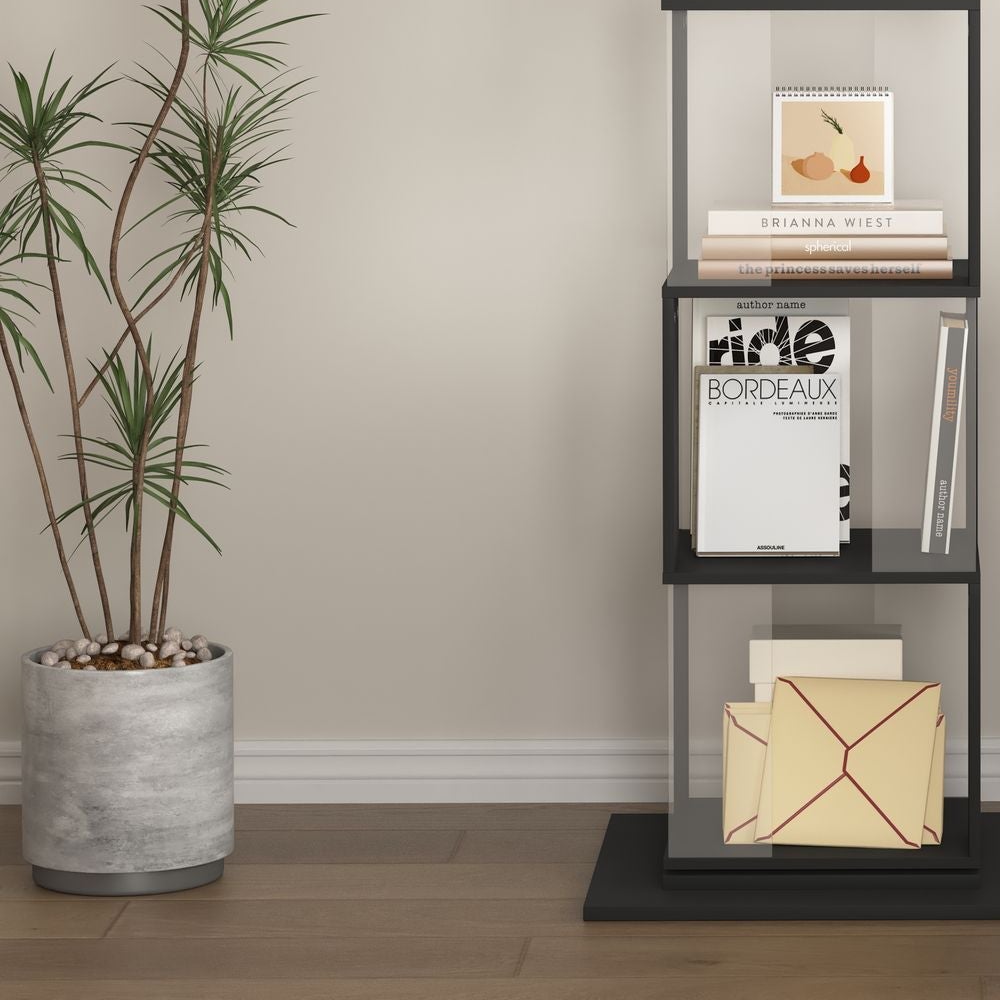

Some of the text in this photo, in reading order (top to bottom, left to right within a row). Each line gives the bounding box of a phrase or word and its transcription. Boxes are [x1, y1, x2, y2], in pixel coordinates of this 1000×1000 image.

[761, 217, 892, 228] BRIANNA WIEST
[804, 241, 851, 254] spherical
[738, 264, 921, 277] the princess saves herself
[736, 301, 774, 309] author
[709, 315, 836, 374] ride
[708, 378, 837, 400] BORDEAUX
[942, 366, 959, 423] youmility
[935, 479, 949, 538] author name
